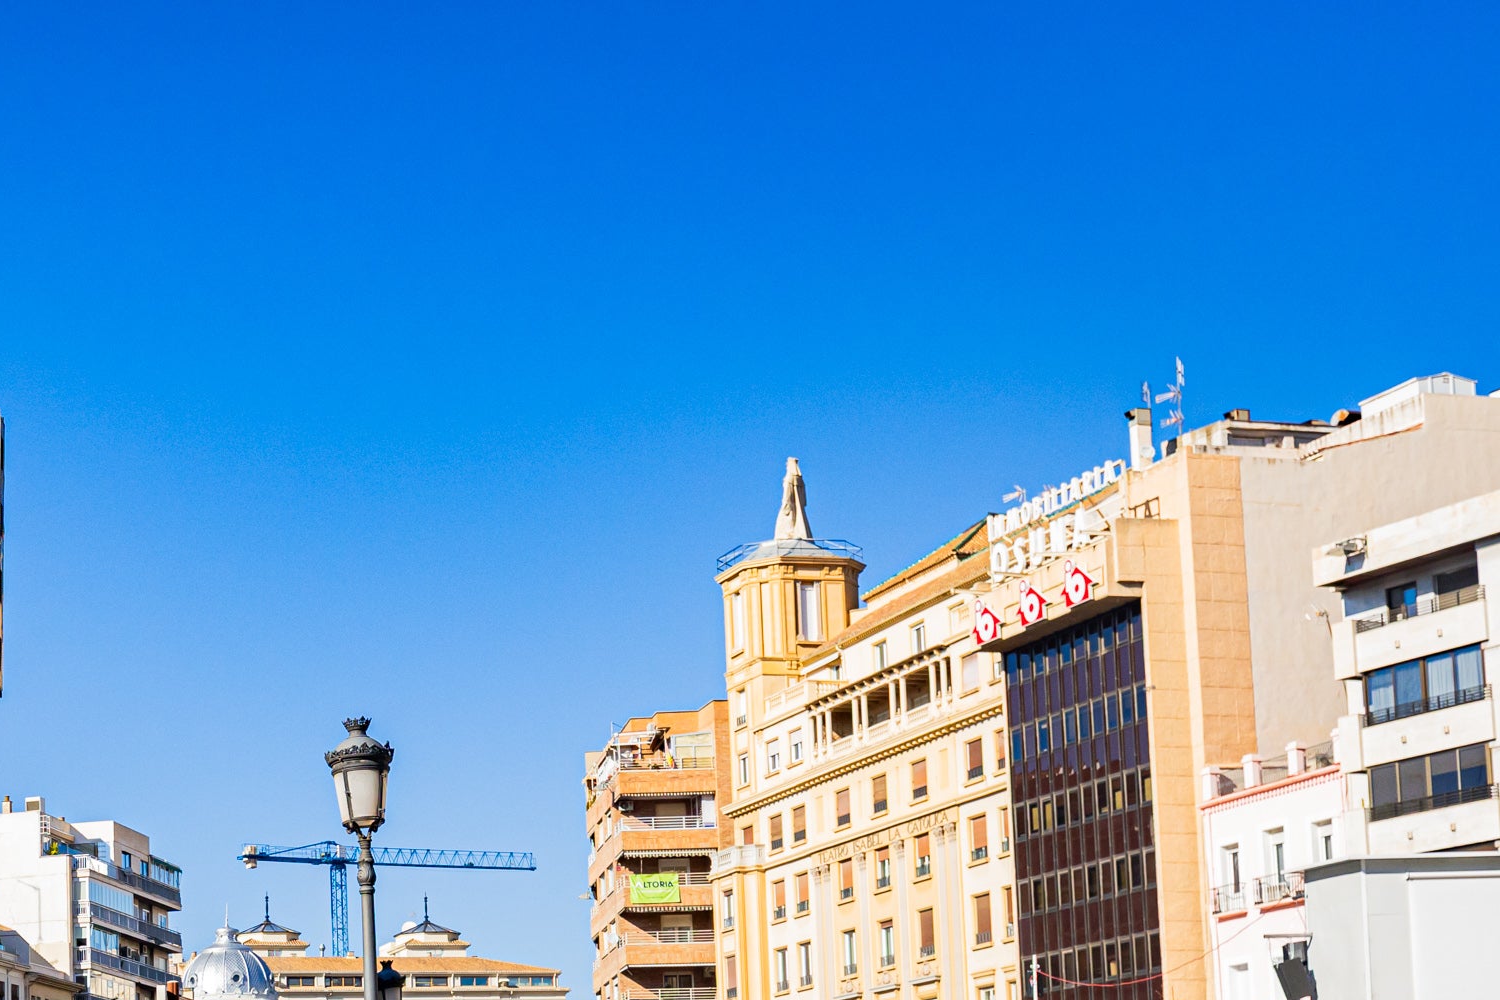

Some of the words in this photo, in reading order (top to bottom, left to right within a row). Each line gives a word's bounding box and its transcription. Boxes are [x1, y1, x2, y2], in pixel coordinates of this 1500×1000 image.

[987, 459, 1117, 541] INMOBILIARIA
[991, 507, 1091, 574] OSUNA
[819, 846, 849, 864] TEATRO
[853, 832, 883, 853] ISABEL
[889, 828, 900, 842] LA
